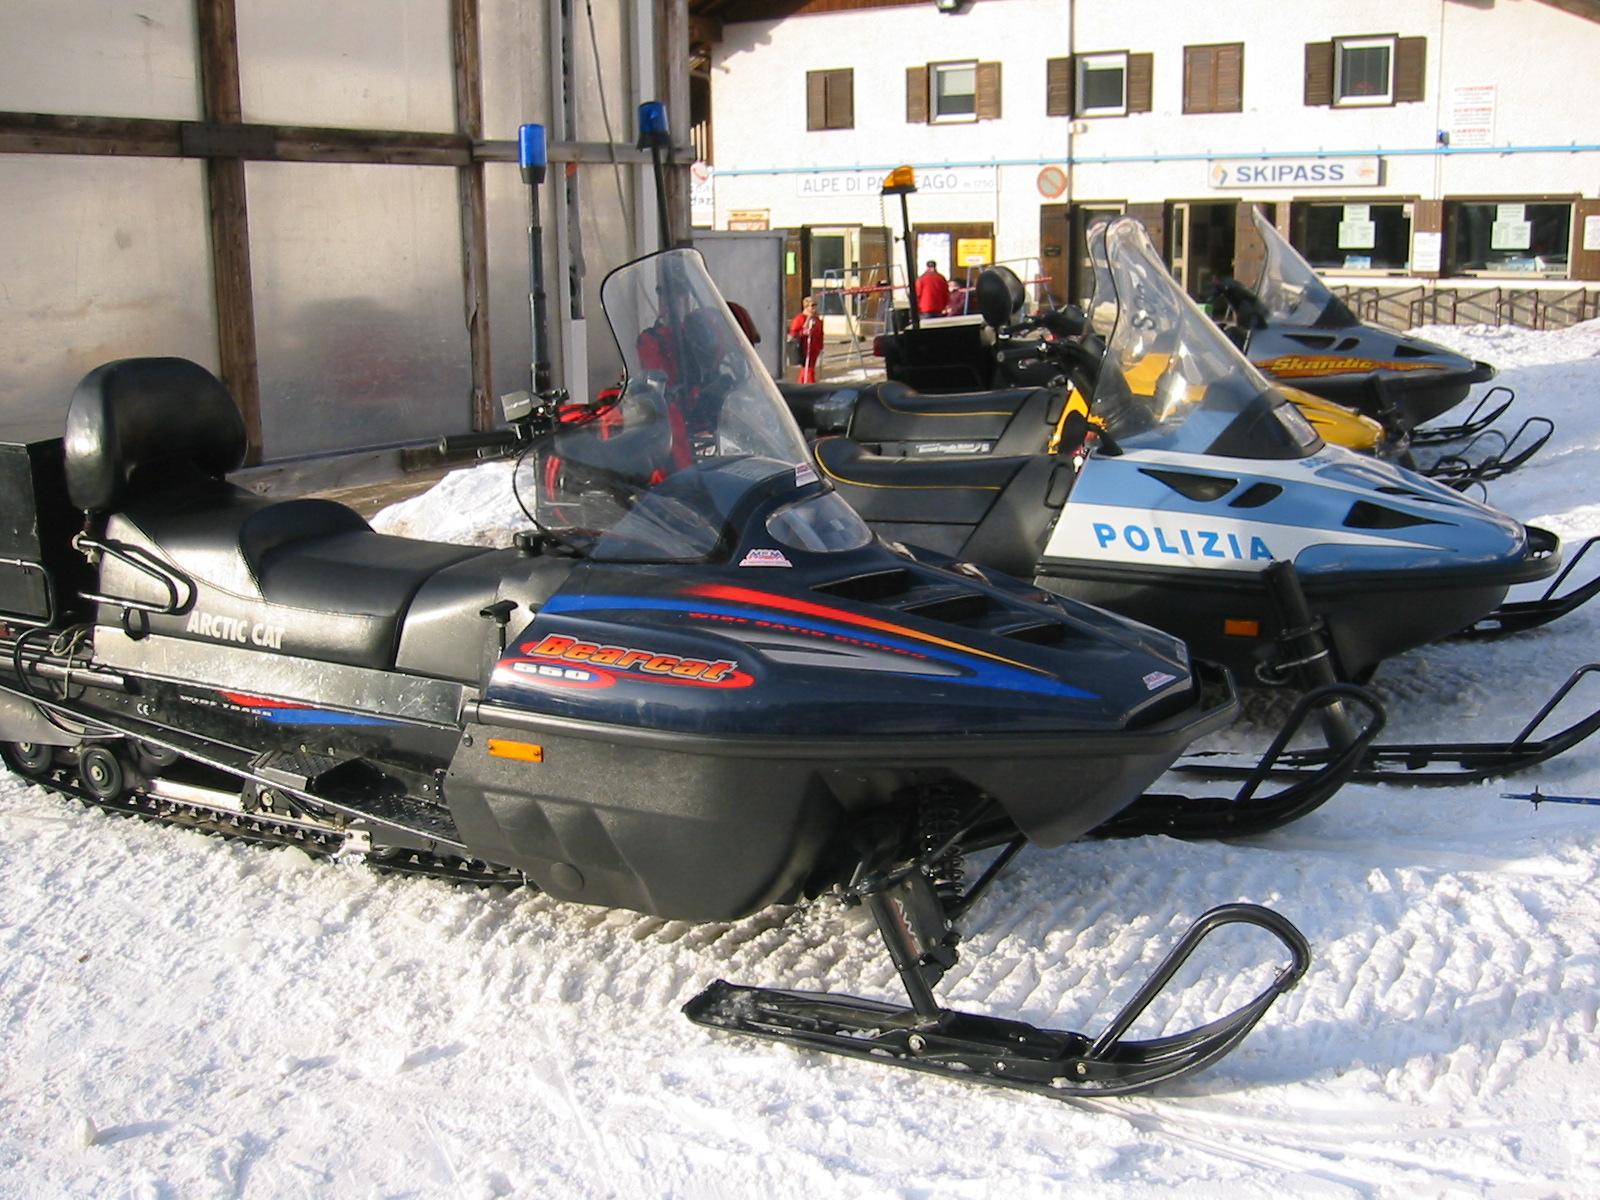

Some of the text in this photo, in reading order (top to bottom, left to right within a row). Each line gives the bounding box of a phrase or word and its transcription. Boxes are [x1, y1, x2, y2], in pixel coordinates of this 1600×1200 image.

[803, 177, 841, 193] ALPE
[846, 176, 860, 192] DI
[867, 174, 957, 191] PAEAGO
[1236, 164, 1344, 182] SKIPASS
[1271, 358, 1373, 370] Skandic
[1093, 523, 1274, 560] POLIZIA
[186, 611, 286, 650] ARCTIC CAT
[529, 634, 736, 682] Bearcat
